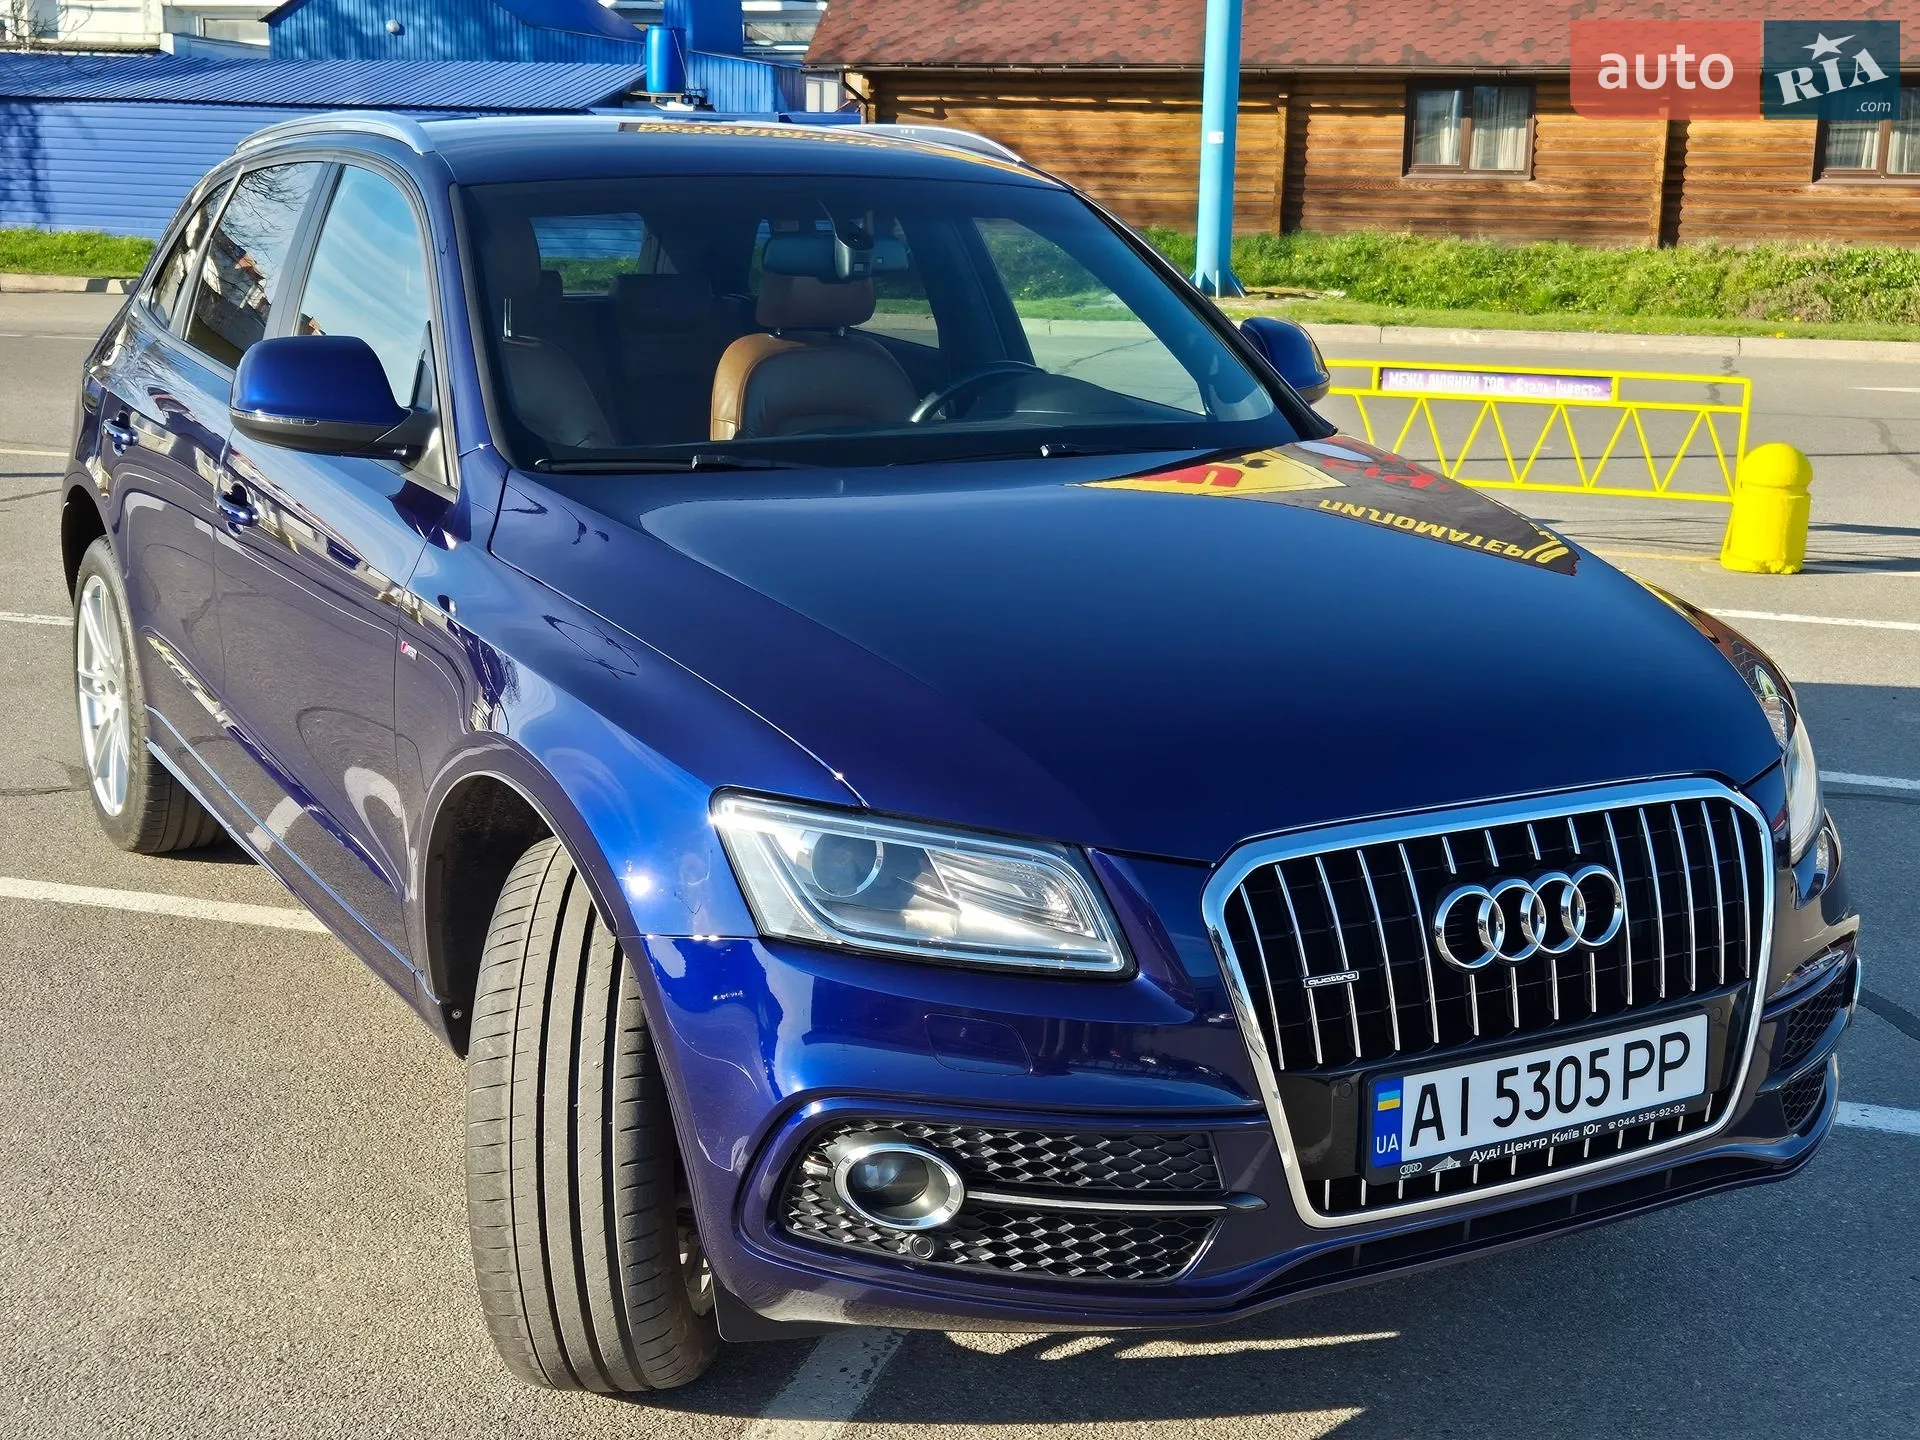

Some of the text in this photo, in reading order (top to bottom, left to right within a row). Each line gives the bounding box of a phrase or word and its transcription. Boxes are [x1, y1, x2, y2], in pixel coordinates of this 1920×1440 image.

[1388, 371, 1424, 389] МЕЖА
[1307, 972, 1356, 987] quattro
[1492, 1047, 1612, 1128] 5305
[1376, 1133, 1399, 1155] UA
[1469, 1103, 1686, 1163] Ауді Центр Київ Юг 044 536-92-92
